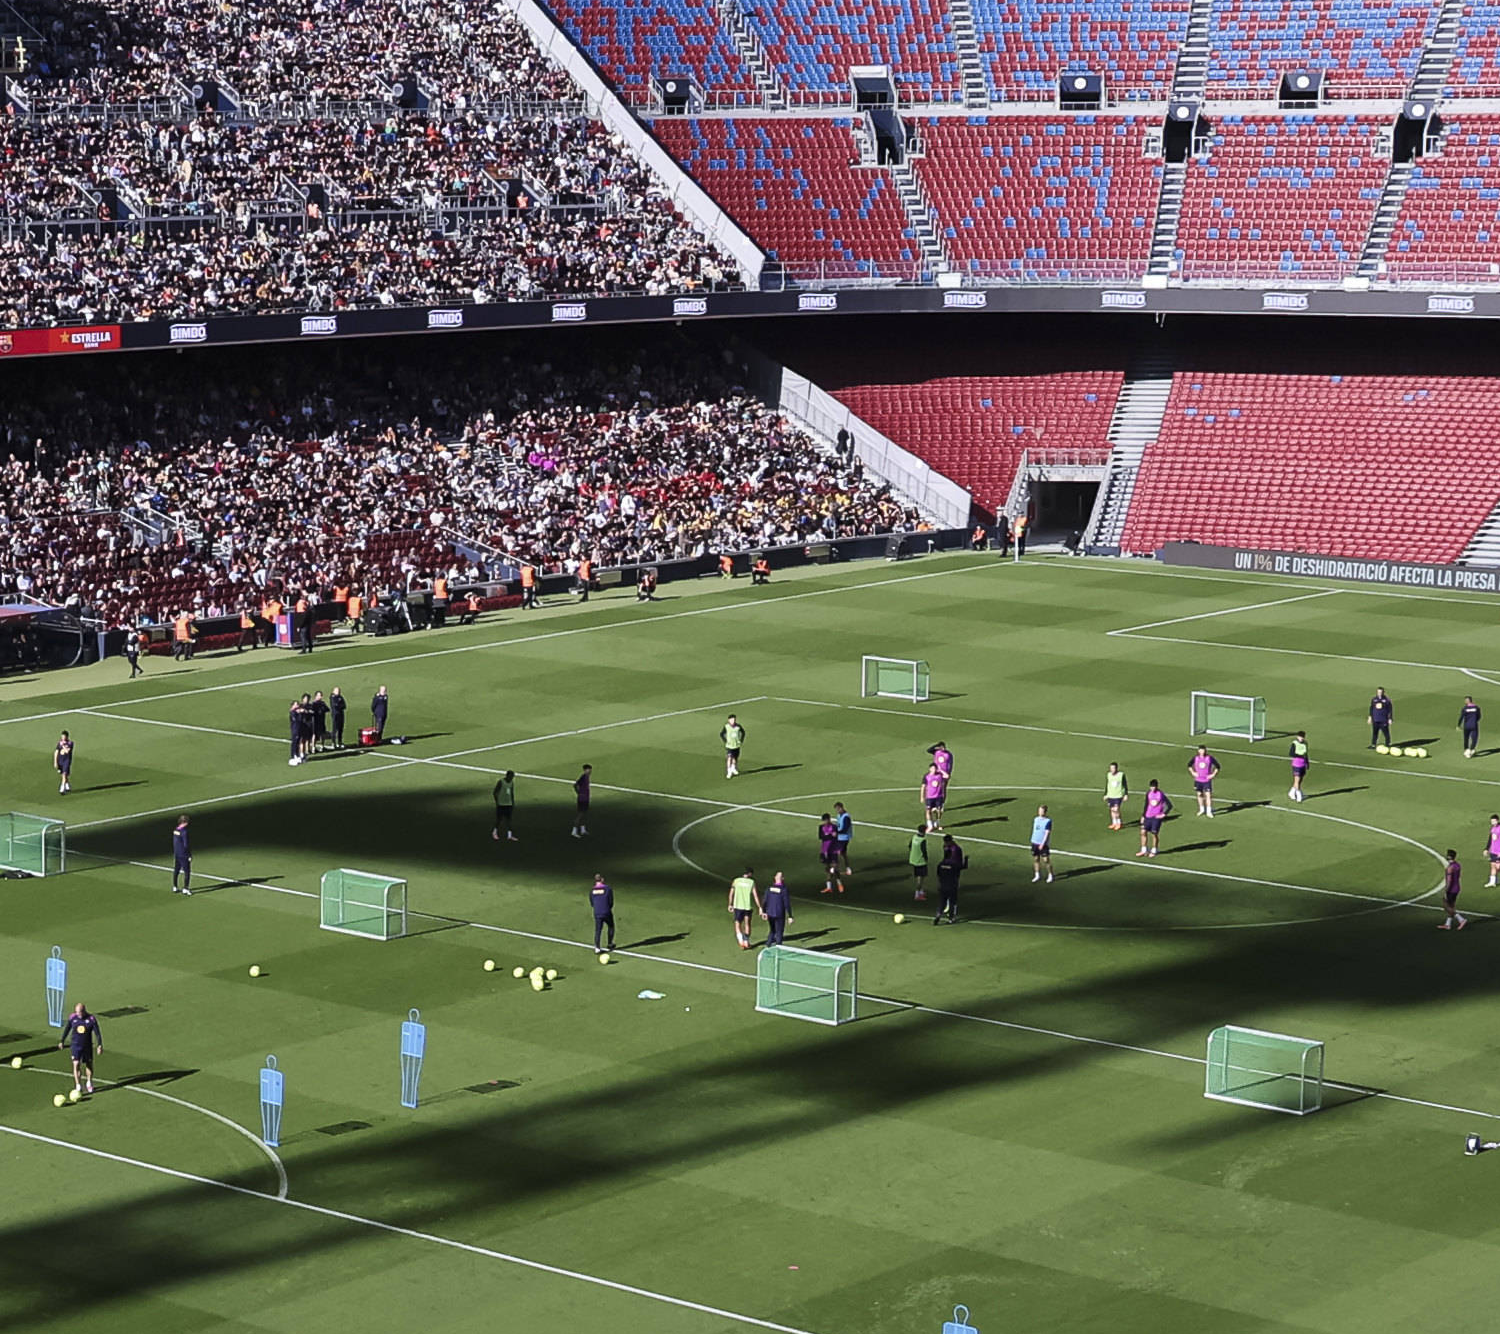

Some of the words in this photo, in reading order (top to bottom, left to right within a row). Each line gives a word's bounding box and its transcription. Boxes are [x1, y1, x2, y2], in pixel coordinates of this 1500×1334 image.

[799, 296, 837, 308] BIMBO
[943, 293, 986, 306] BIMBO
[1101, 293, 1145, 306] BIMBO
[1263, 296, 1307, 309] BIMBO
[1428, 299, 1473, 312] BIMBO
[552, 307, 585, 319] BIMBO
[674, 301, 706, 313] BIMBO
[301, 319, 336, 332] BIMBO
[428, 313, 462, 325] BIMBO
[71, 331, 112, 344] ESTRELLA
[170, 326, 206, 341] BIMBO
[1235, 552, 1252, 571] UN
[1254, 553, 1272, 571] 1%
[1275, 555, 1291, 573] DE
[1293, 557, 1387, 581] DESHIDRATACIÓ
[1390, 564, 1435, 584] AFECTA
[1437, 568, 1453, 586] LA
[1455, 571, 1495, 589] PRESA
